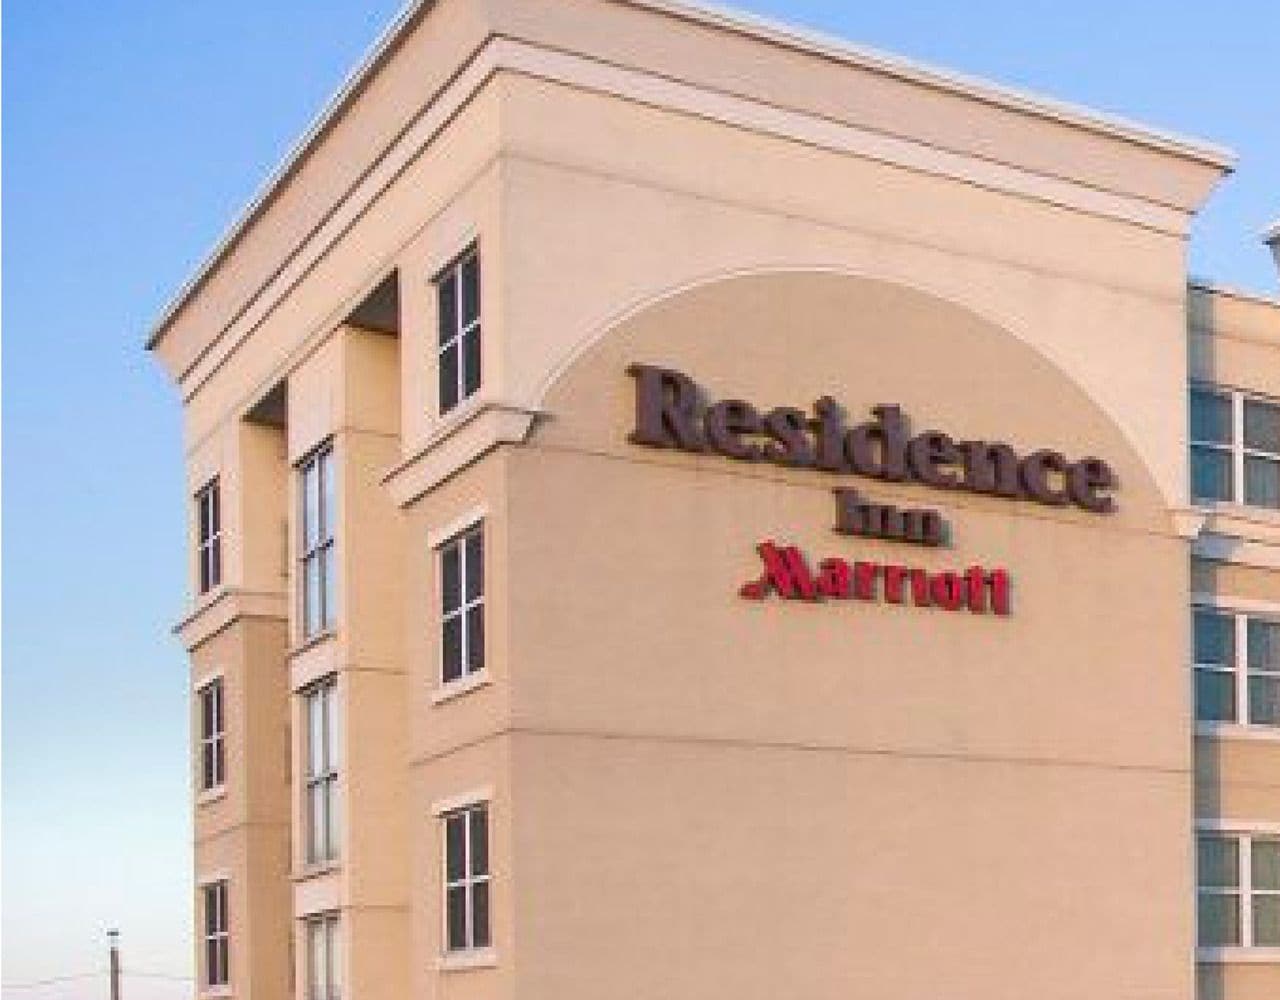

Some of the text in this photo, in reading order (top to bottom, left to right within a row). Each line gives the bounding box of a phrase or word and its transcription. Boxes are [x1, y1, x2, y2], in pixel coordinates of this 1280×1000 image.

[627, 363, 1117, 513] Residence
[832, 487, 949, 547] Inn
[740, 540, 1012, 615] Marriott
